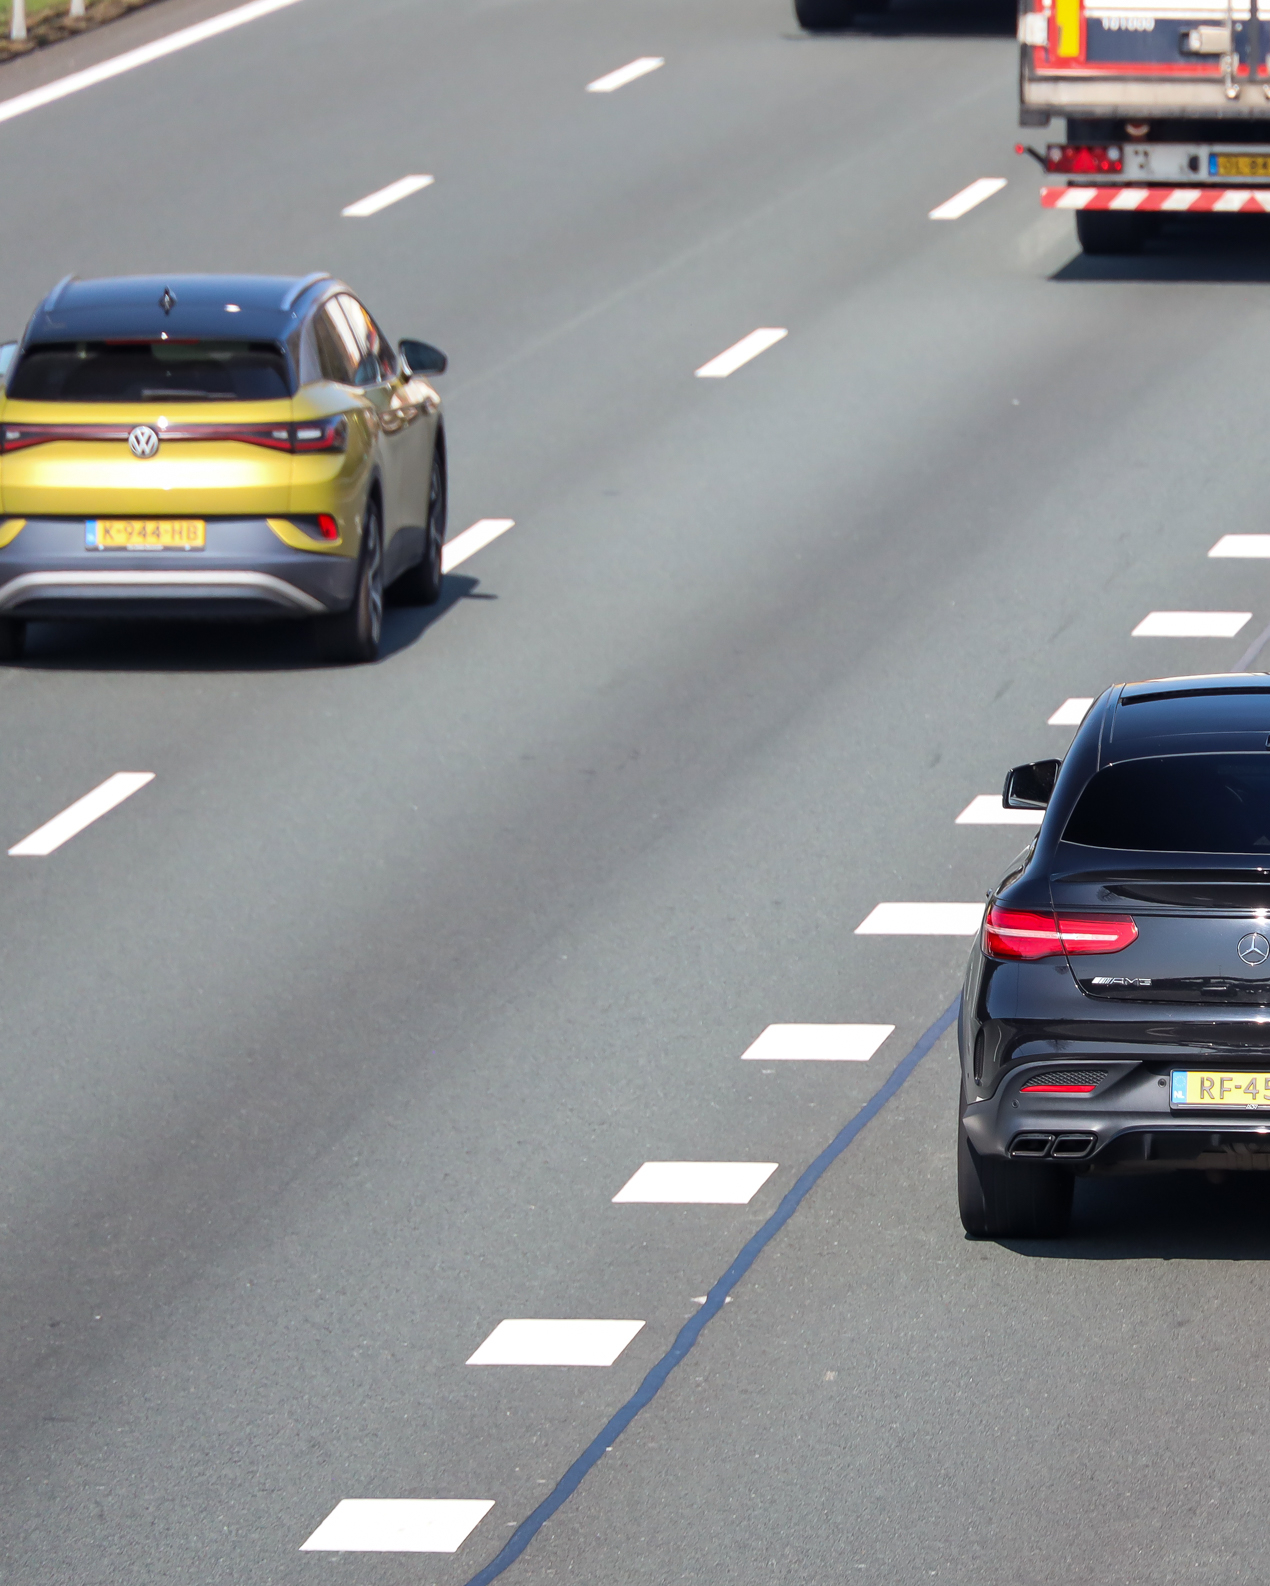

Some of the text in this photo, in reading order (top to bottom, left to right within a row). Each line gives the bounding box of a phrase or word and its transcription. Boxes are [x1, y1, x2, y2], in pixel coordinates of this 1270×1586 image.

[103, 522, 199, 542] K-944-HB
[1109, 977, 1152, 987] AMG
[1174, 1090, 1186, 1099] NL
